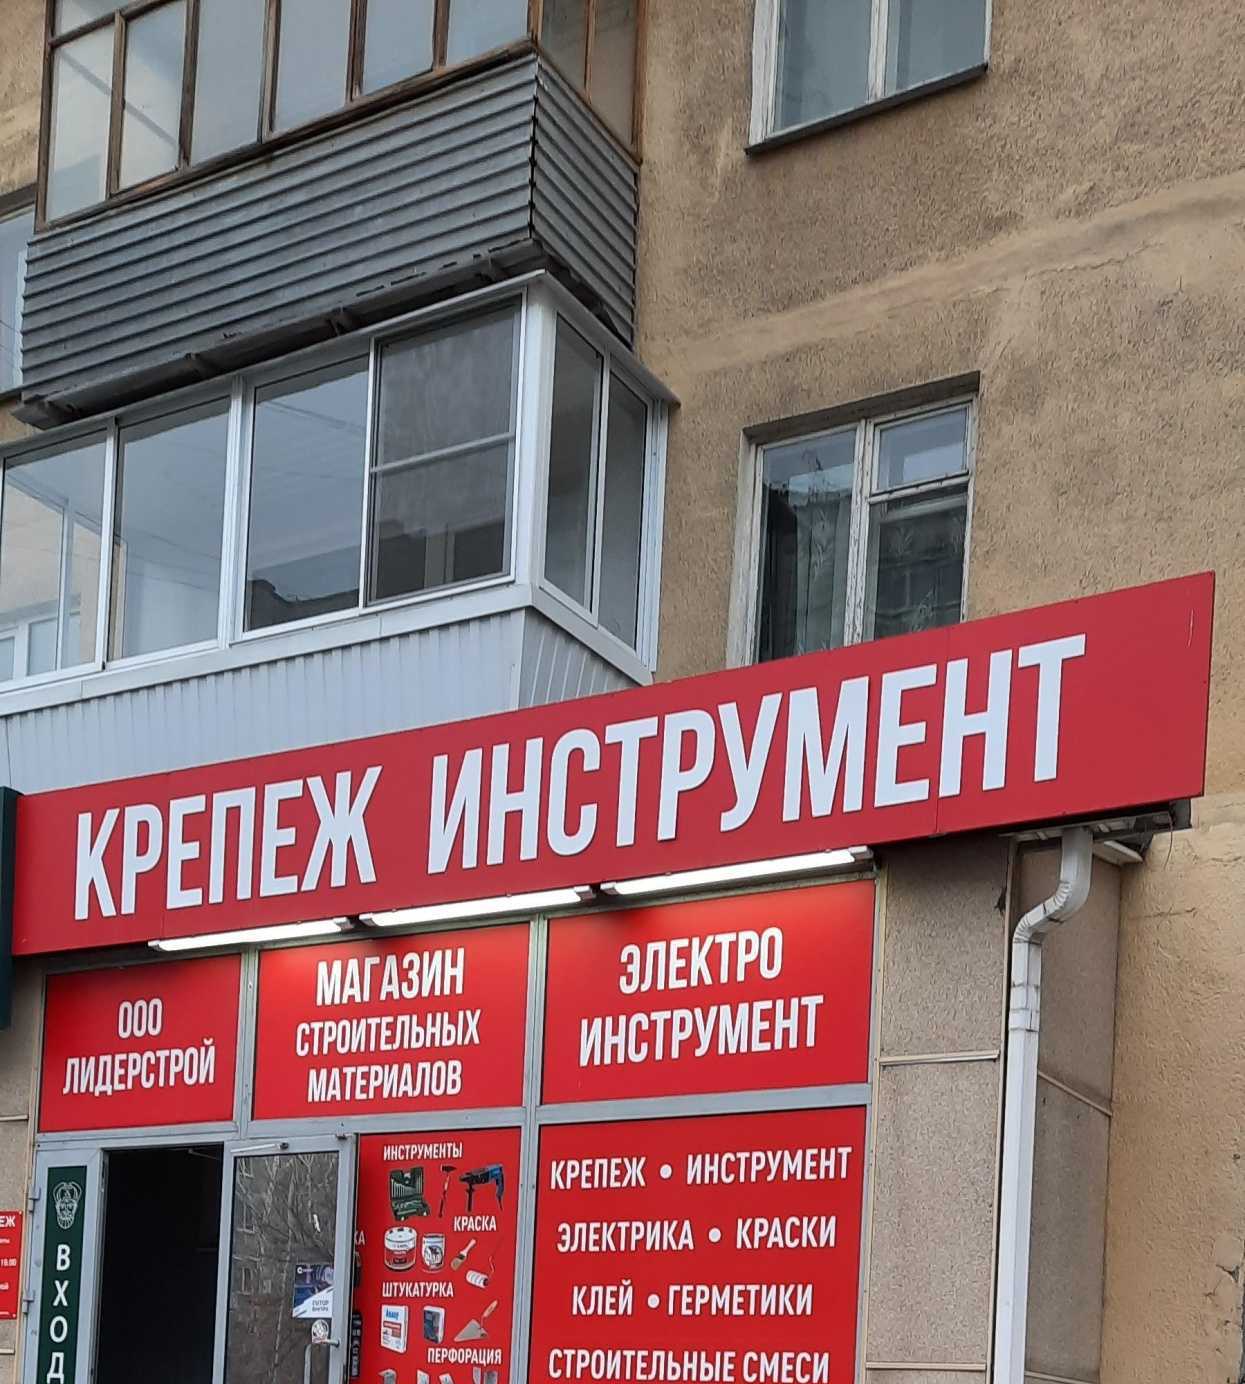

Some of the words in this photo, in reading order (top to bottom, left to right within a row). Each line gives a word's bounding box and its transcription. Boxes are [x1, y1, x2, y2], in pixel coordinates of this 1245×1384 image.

[74, 766, 382, 921] КРЕПЕЖ
[427, 634, 1086, 874] ИНСТРУМЕНТ
[316, 948, 465, 1006] МАГАЗИН
[619, 927, 783, 994] ЭЛЕКТРО
[118, 998, 163, 1039] ООО
[296, 1009, 481, 1057] СТРОИТЕЛЬНЫХ
[579, 995, 824, 1067] ИНСТРУМЕНТ
[62, 1037, 216, 1096] ЛИДЕРСТРОЙ
[307, 1059, 462, 1103] МАТЕРИАЛОВ
[383, 1142, 463, 1161] ИНСТРУМЕНТЫ
[550, 1156, 646, 1190] КРЕПЕЖ
[686, 1146, 852, 1186] ИНСТРУМЕНТ
[453, 1215, 497, 1232] КРАСКА
[557, 1219, 694, 1253] ЭЛЕКТРИКА
[736, 1215, 836, 1249] КРАСКИ
[382, 1281, 454, 1298] ШТУКАТУРКА
[572, 1279, 633, 1316] КЛЕЙ
[668, 1283, 813, 1316] ГЕРМЕТИКИ
[47, 1244, 71, 1384] ВХОД
[427, 1347, 502, 1367] ПЕРФОРАЦИЯ
[548, 1348, 736, 1383] СТРОИТЕЛЬНЫЕ
[742, 1351, 830, 1384] СМЕСИ
